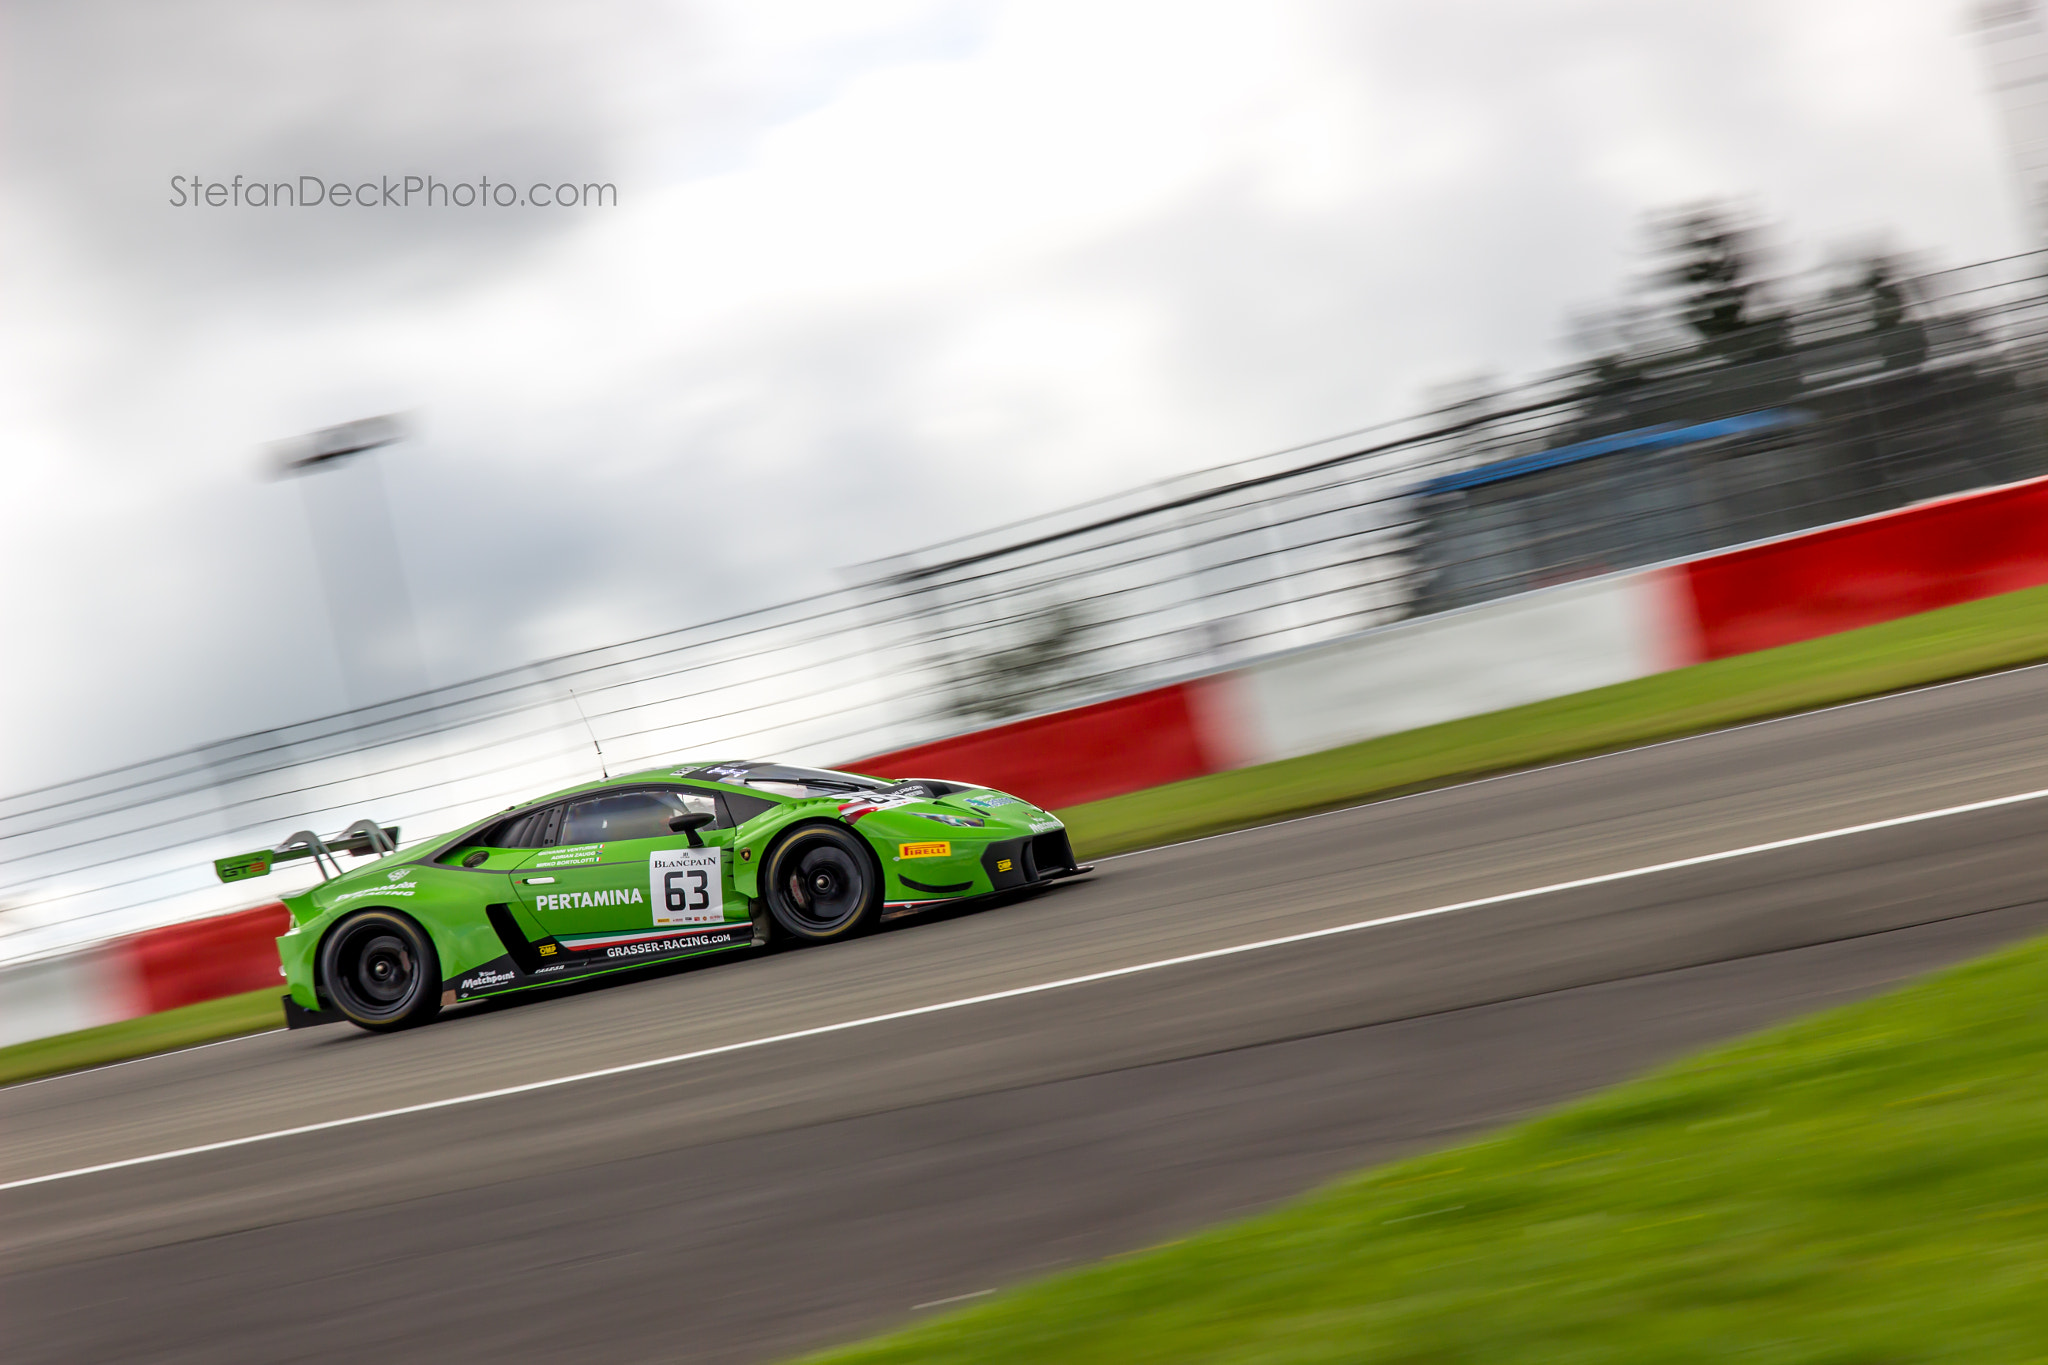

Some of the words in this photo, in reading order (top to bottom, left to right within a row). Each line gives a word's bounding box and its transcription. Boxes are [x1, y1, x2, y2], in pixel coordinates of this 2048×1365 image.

[574, 850, 596, 858] ZAUGG
[904, 844, 946, 856] PIRELLI
[556, 857, 595, 866] BORTOLOTTI
[654, 857, 717, 869] BLANCPAIN
[222, 861, 267, 878] GT3
[664, 870, 710, 912] 63
[536, 888, 644, 912] PERTAMINA
[539, 945, 557, 955] OMP
[461, 971, 515, 989] Matchpoint
